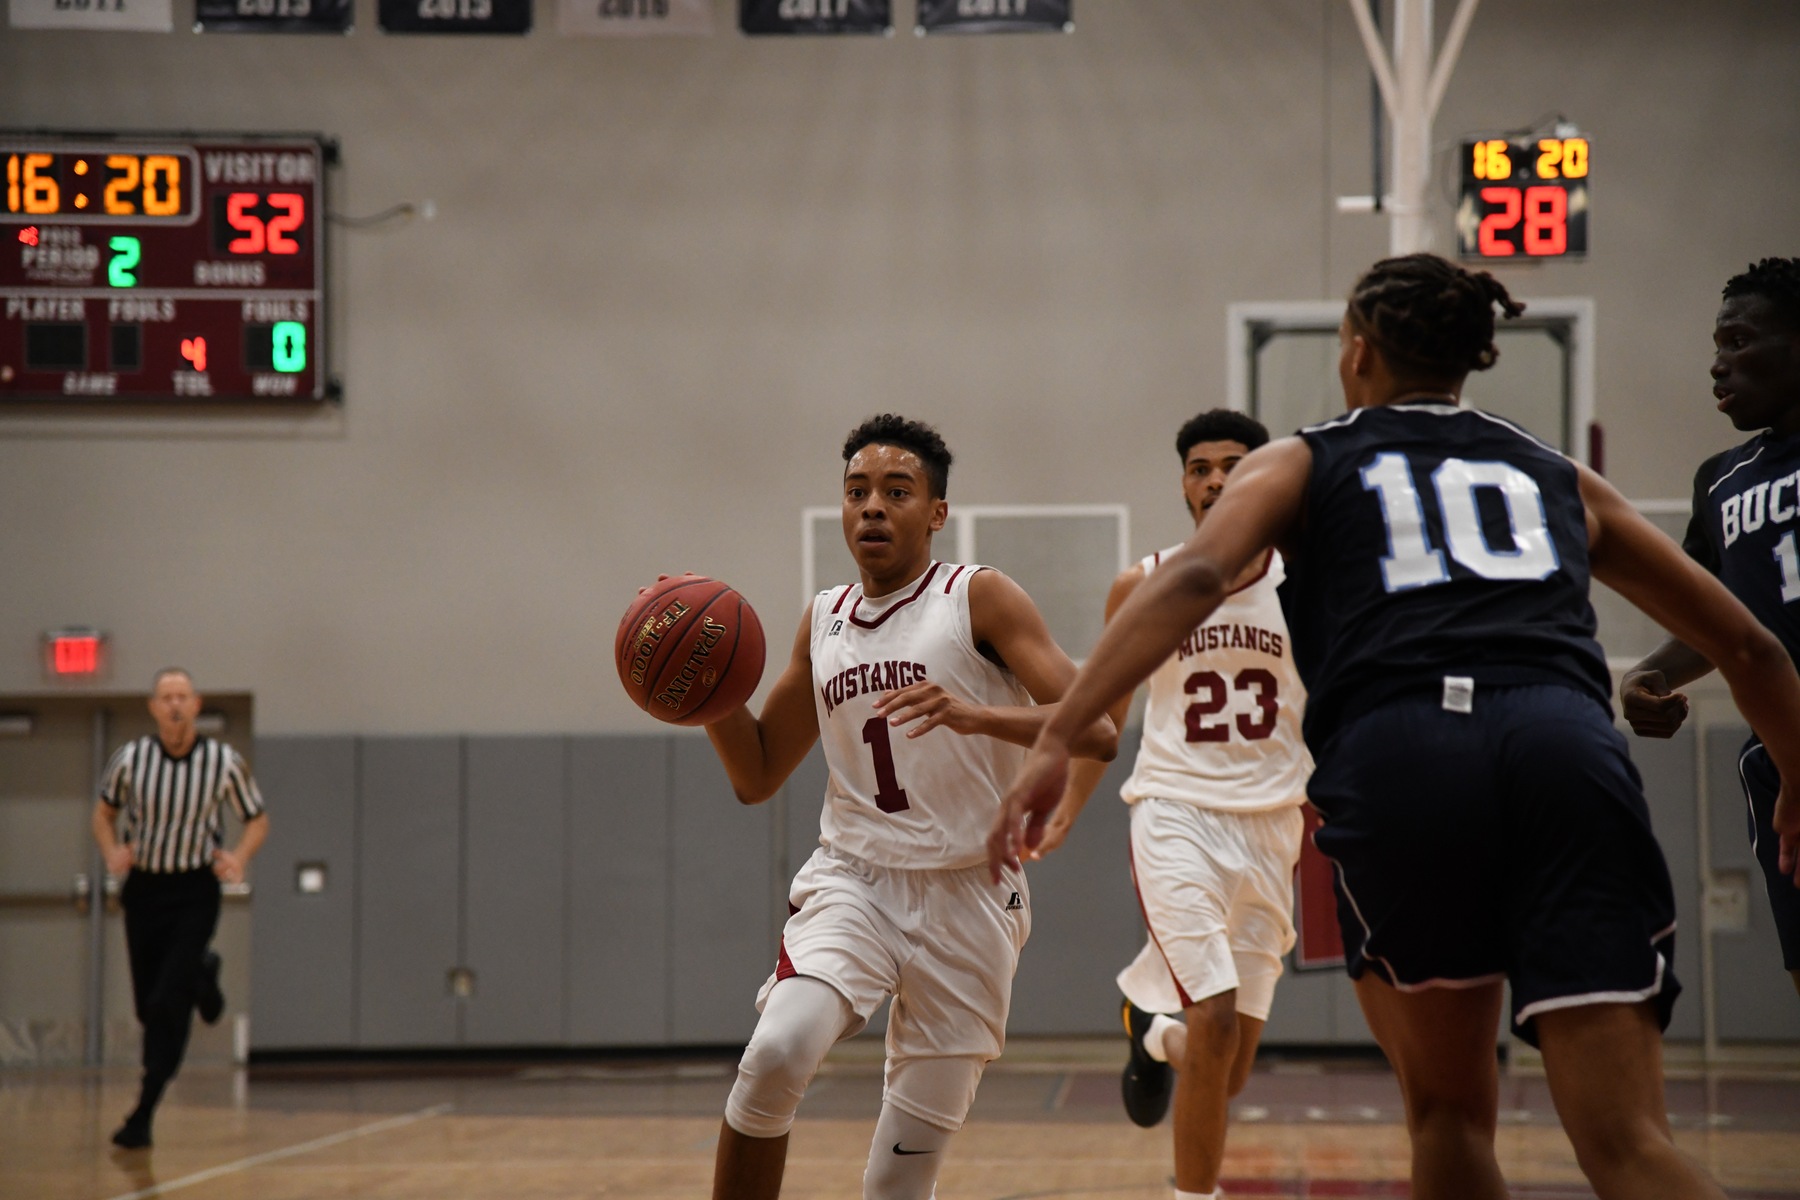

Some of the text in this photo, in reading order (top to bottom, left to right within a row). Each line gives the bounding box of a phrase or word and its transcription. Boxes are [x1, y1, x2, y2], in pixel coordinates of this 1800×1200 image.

[7, 153, 181, 216] 16:20
[204, 151, 315, 183] VISITOR
[1473, 138, 1588, 180] 16 20
[227, 193, 305, 254] 52
[1478, 186, 1567, 257] 28
[21, 246, 100, 270] PERIOD
[108, 236, 141, 287] 2
[6, 296, 176, 322] PLAYER FOULS
[242, 297, 309, 323] FOULS
[181, 336, 206, 373] 4
[272, 321, 306, 373] 0
[1358, 451, 1561, 593] 10
[1721, 469, 1800, 549] BUC
[656, 616, 726, 710] SPALDING
[1178, 624, 1284, 661] MUSTANGS
[821, 660, 927, 718] MUSTANGS
[1184, 668, 1279, 742] 23
[862, 716, 910, 814] 1
